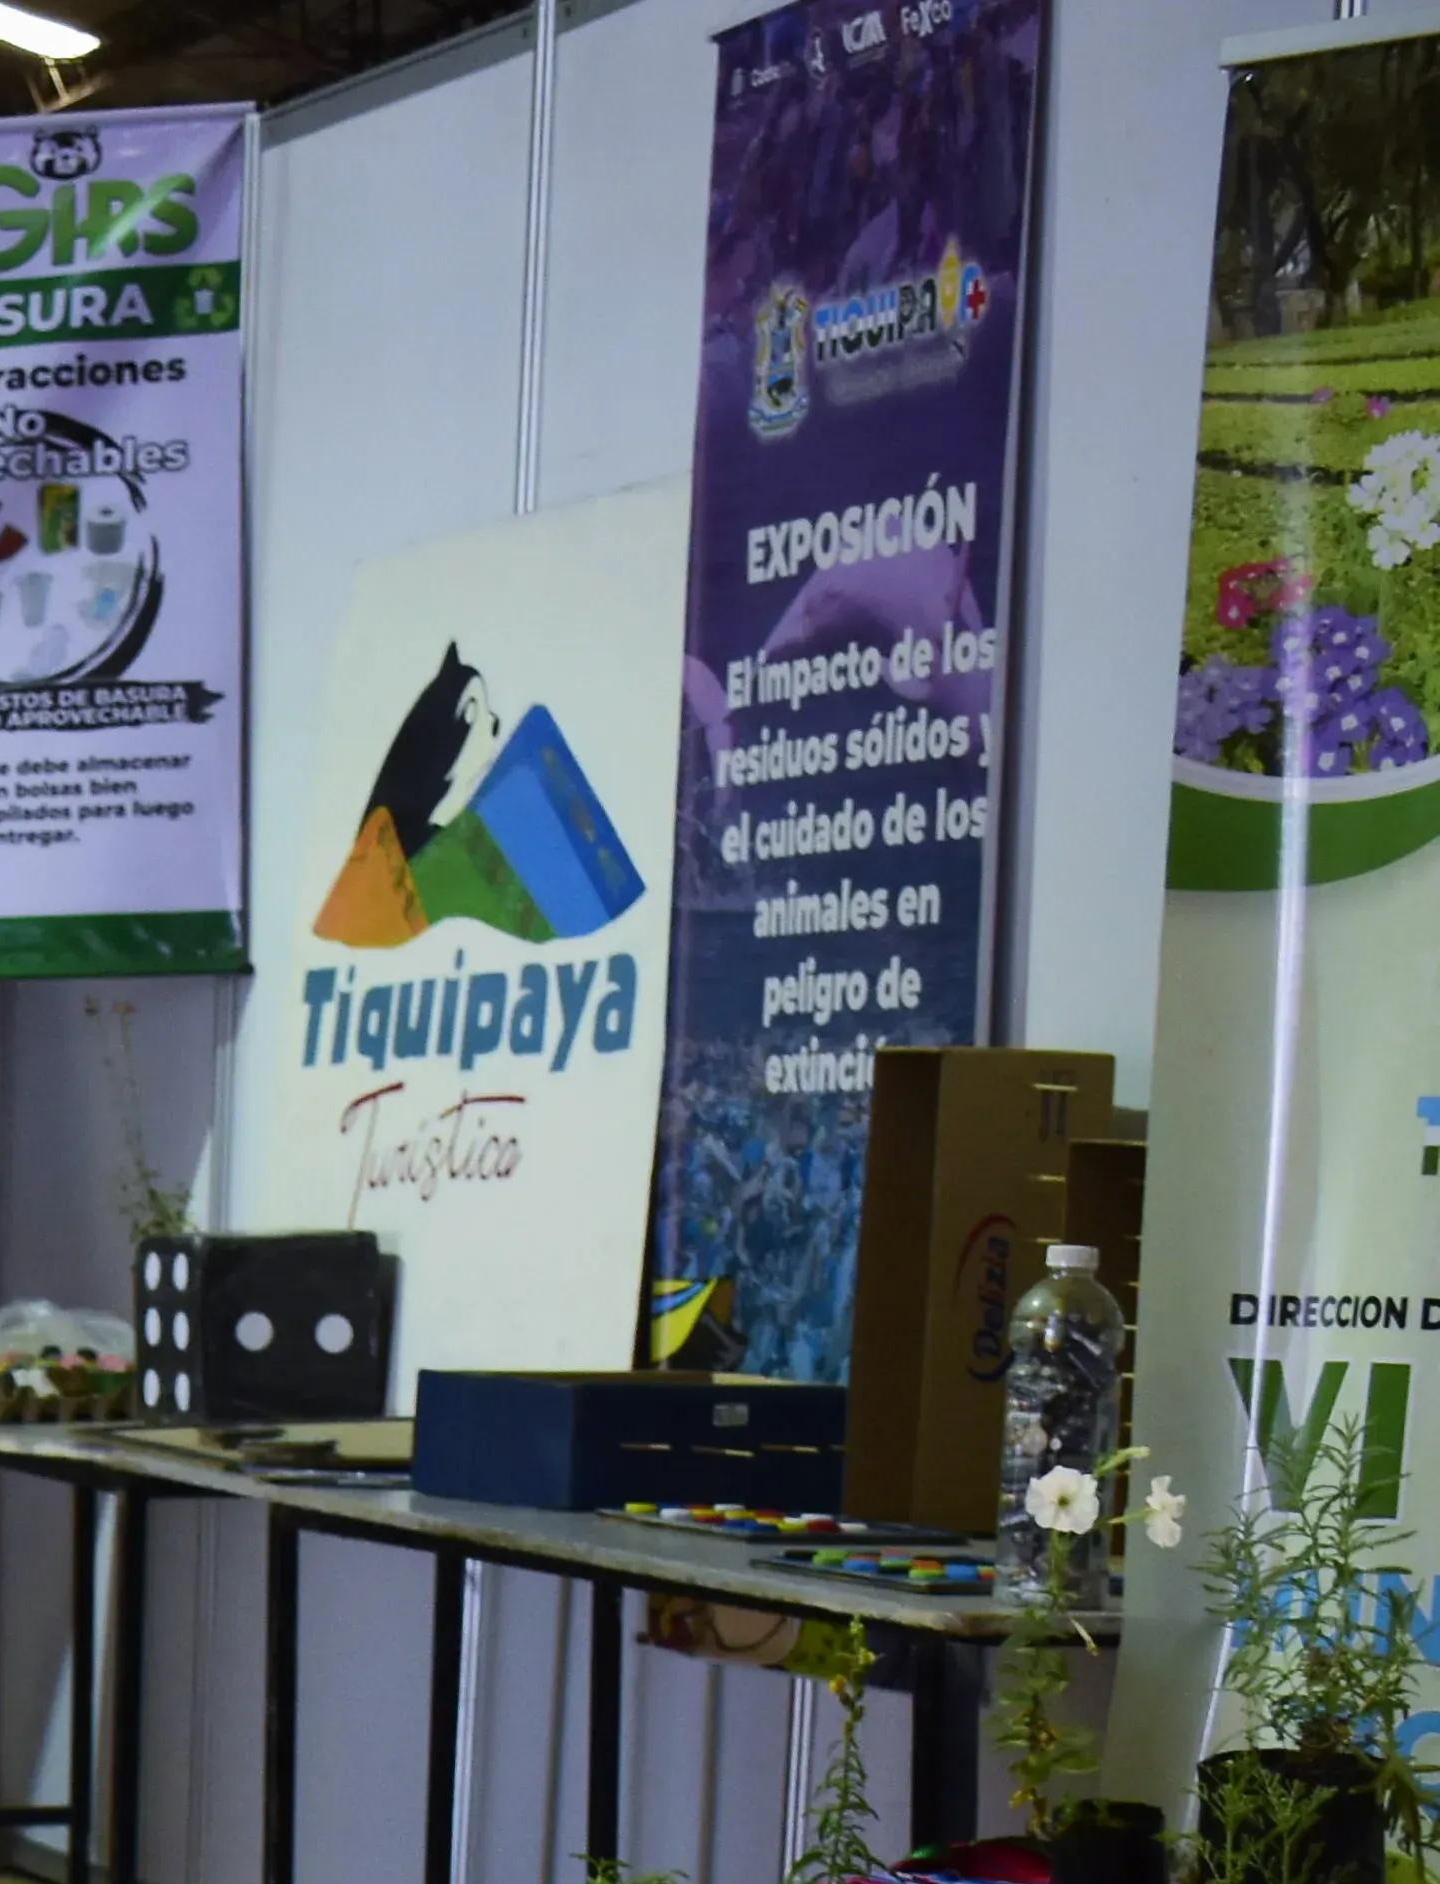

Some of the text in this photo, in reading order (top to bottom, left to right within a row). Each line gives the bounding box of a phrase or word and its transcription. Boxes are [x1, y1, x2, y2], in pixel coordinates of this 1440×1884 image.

[747, 472, 977, 585] EXPOSICIÓN
[57, 690, 87, 707] DE
[94, 686, 187, 705] BASURA
[725, 621, 997, 710] El impacto de los
[5, 705, 187, 729] APROVECHABLE
[715, 725, 839, 789] residuos
[845, 706, 970, 771] sólidos
[16, 758, 70, 776] debe
[76, 754, 192, 773] almacenar
[721, 794, 987, 864] el cuidado de los
[753, 880, 941, 940] animales en
[301, 949, 639, 1073] Tiquipaya
[761, 956, 921, 1028] peligro de
[1229, 1292, 1408, 1330] DIRECCION
